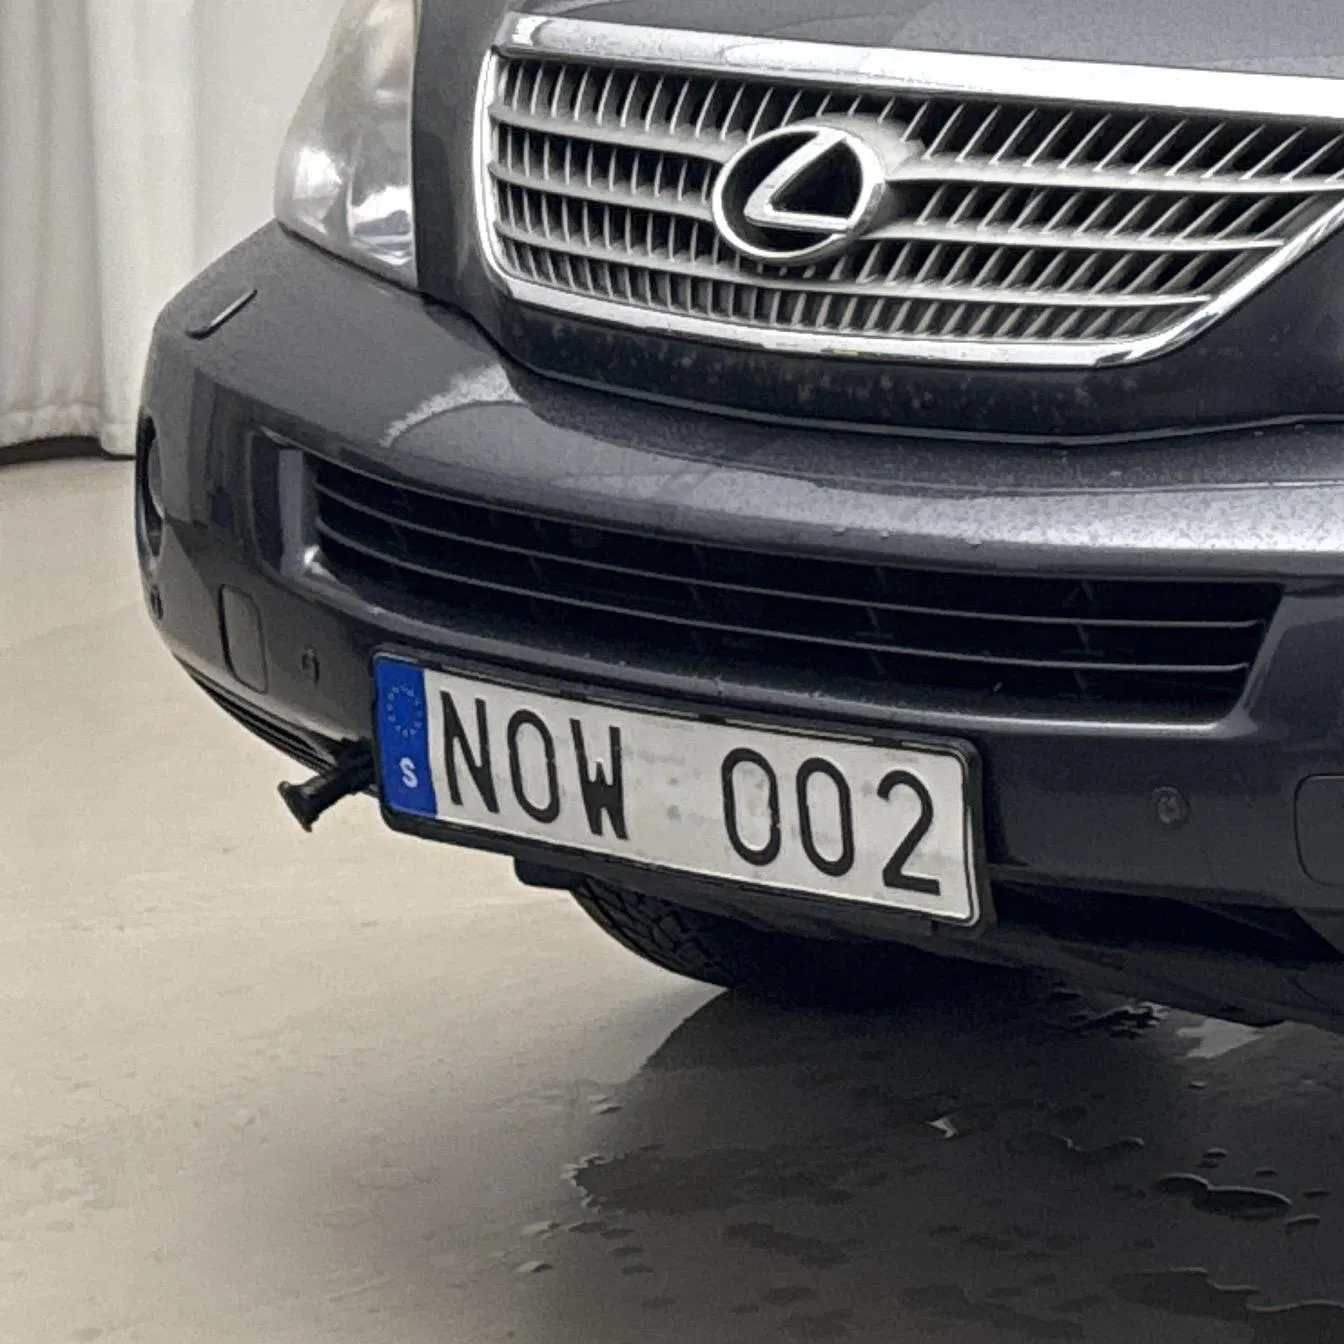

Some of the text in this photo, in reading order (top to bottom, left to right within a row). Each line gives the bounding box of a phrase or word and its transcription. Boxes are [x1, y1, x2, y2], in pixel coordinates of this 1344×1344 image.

[399, 757, 419, 789] S
[438, 689, 942, 897] NOW 002
